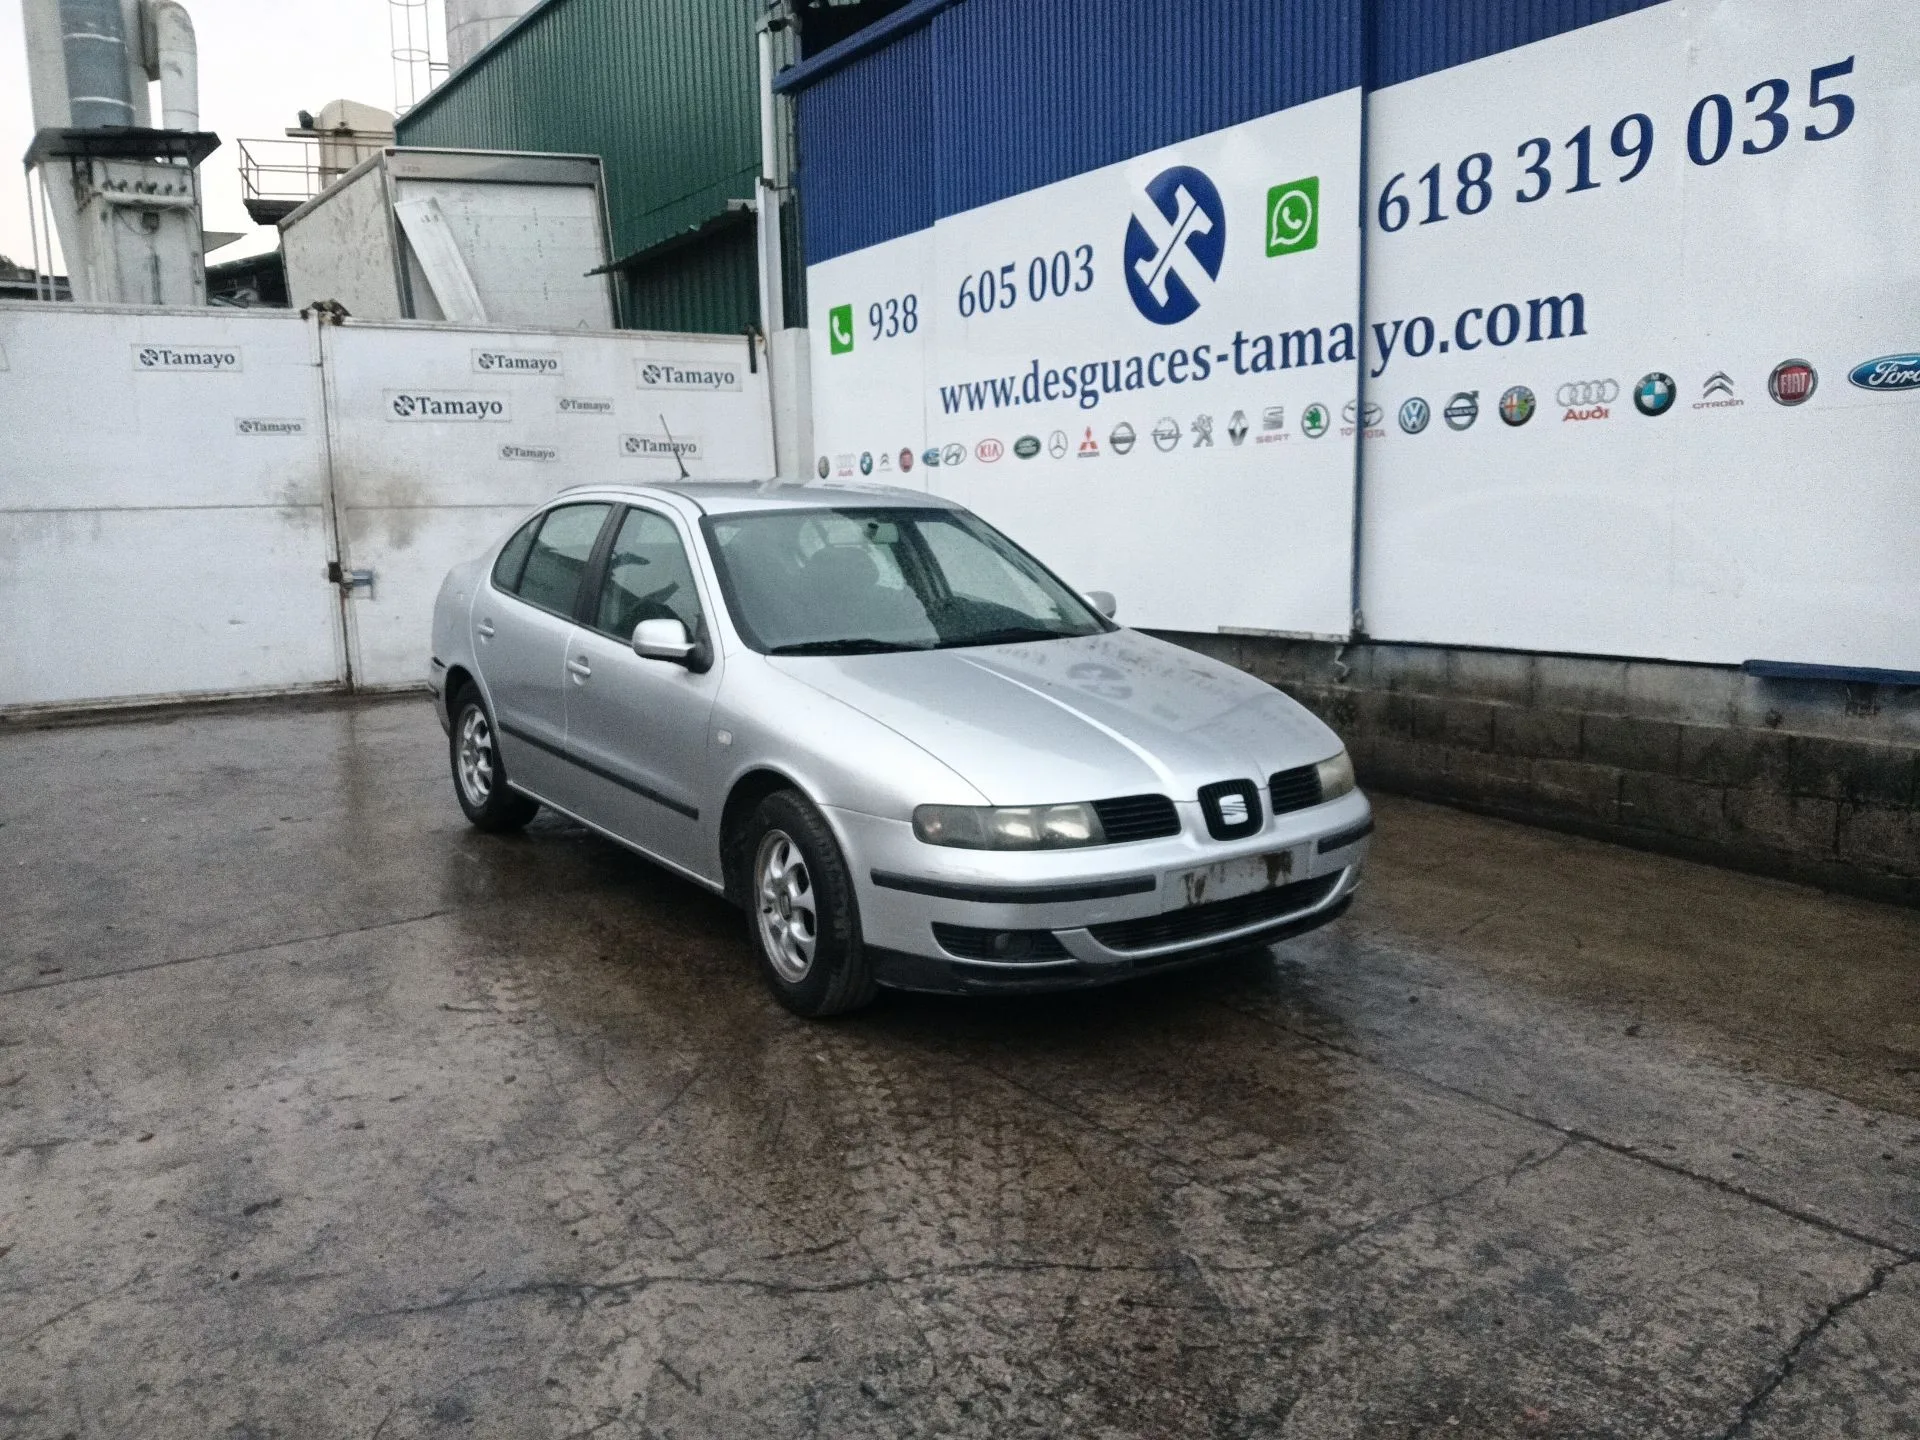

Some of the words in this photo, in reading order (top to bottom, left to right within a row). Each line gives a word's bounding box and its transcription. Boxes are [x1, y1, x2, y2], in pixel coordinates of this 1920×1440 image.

[1378, 152, 1494, 233] 618
[1514, 112, 1655, 203] 319
[1685, 56, 1857, 166] 035
[868, 294, 918, 341] 938
[958, 261, 1017, 317] 605
[1028, 244, 1094, 301] 003
[159, 349, 236, 368] Tamayo
[494, 354, 558, 373] Tamayo
[661, 366, 735, 389] Tamayo
[1780, 372, 1808, 394] FIAT
[415, 396, 504, 420] Tamayo
[569, 400, 611, 412] Tamayo
[1562, 405, 1610, 422] Audi
[252, 420, 301, 433] Tamayo
[513, 448, 556, 460] Tamayo
[639, 438, 697, 454] Tamayo
[979, 445, 1000, 458] KIA
